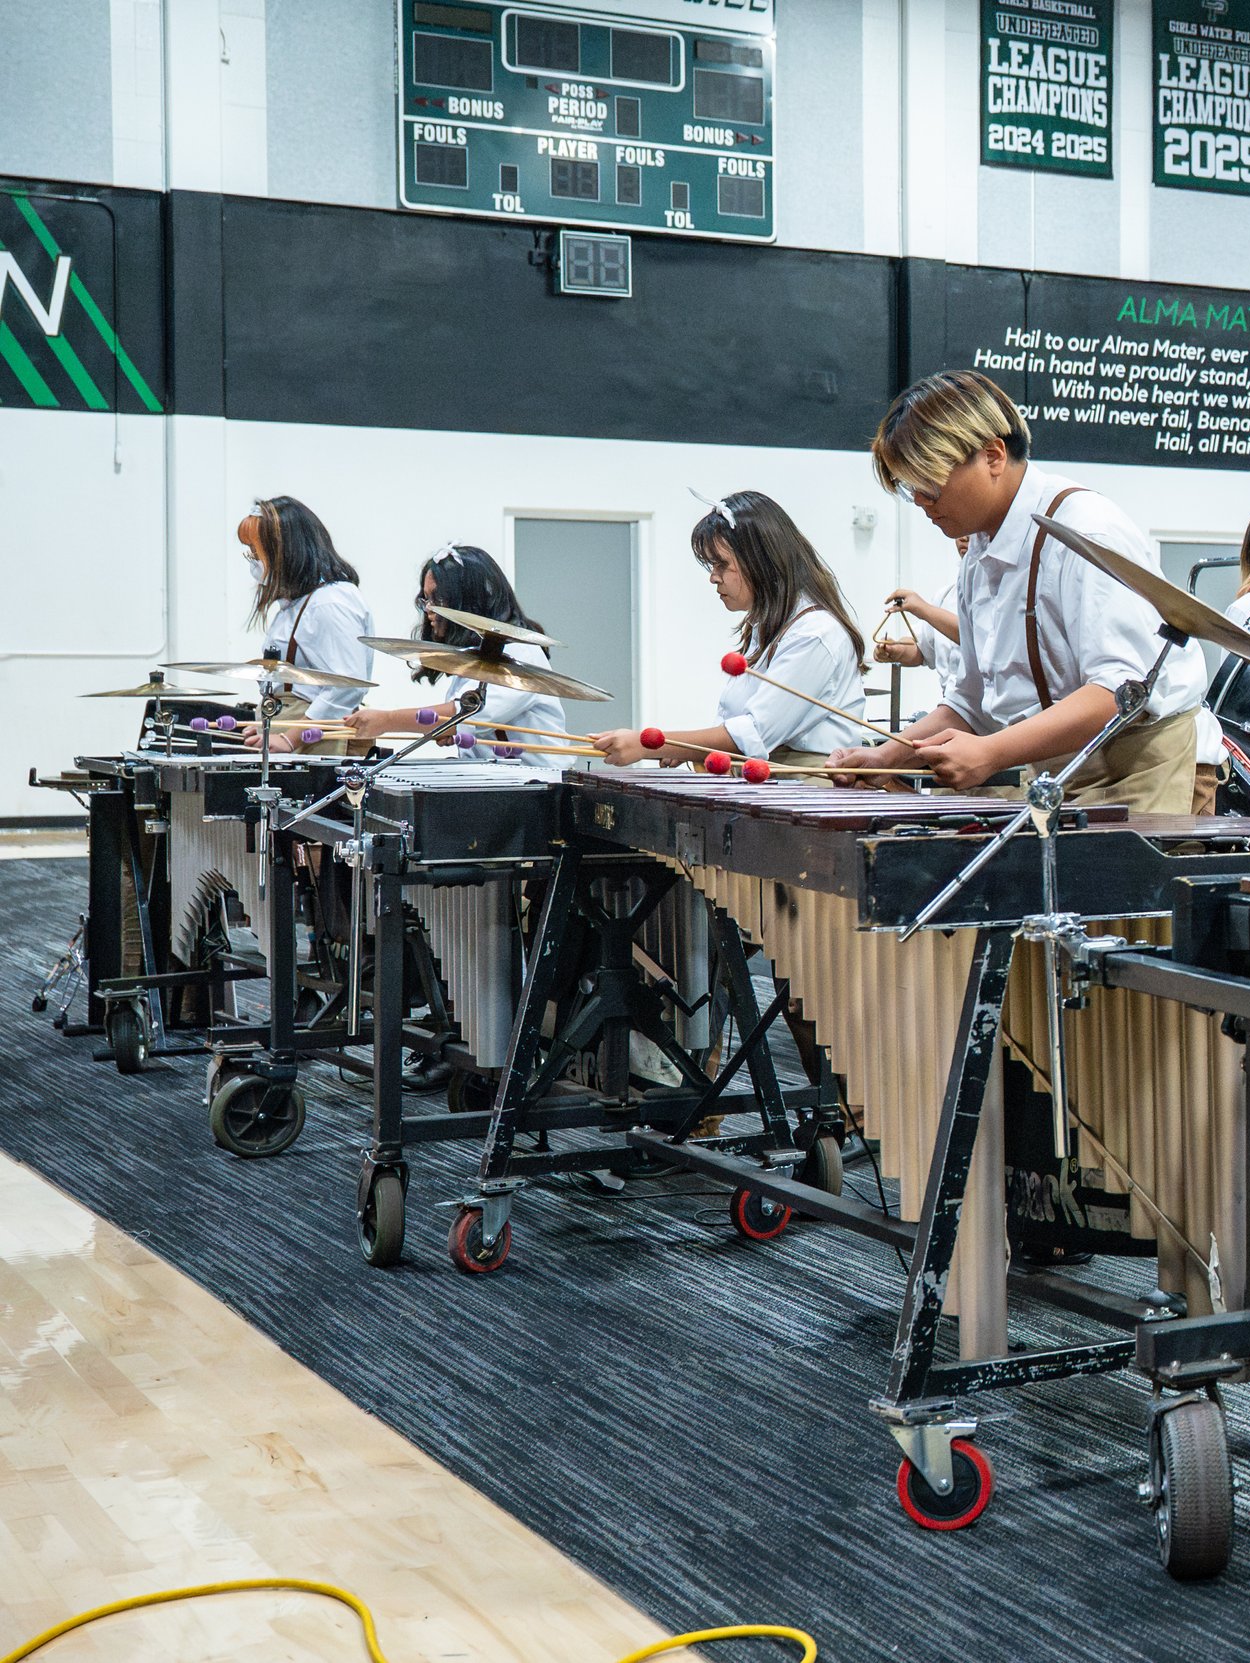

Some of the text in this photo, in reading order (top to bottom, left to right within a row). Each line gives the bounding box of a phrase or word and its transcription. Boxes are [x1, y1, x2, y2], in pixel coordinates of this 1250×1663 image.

[1032, 0, 1096, 18] BASKETBALL
[997, 13, 1099, 47] UNDEFEATED
[1169, 20, 1197, 35] GIRLS
[1200, 24, 1233, 40] WATER
[988, 37, 1107, 88] LEAGUE
[561, 82, 594, 99] POSS
[988, 75, 1107, 128] CHAMPIONS
[448, 96, 505, 120] BONUS
[548, 96, 608, 119] PERIOD
[413, 123, 468, 145] FOULS
[683, 124, 735, 147] BONUS
[988, 124, 1107, 164] 2024 2025
[537, 137, 599, 160] PLAYER
[615, 145, 665, 167] FOULS
[718, 157, 765, 178] FOULS
[492, 192, 525, 213] TOL
[664, 210, 695, 229] TOL
[1116, 295, 1198, 328] ALMA
[1004, 326, 1041, 349] Hail
[1044, 332, 1064, 350] to
[1067, 336, 1100, 352] our
[1100, 335, 1149, 357] Alma
[1152, 338, 1206, 364] Mater,
[1211, 348, 1249, 364] ever
[973, 348, 1027, 372] Hand
[1028, 355, 1045, 373] in
[1049, 353, 1096, 376] hand
[1099, 362, 1125, 378] we
[1128, 362, 1198, 387] proudly
[1199, 367, 1250, 390] stand,
[1052, 378, 1095, 400] With
[1098, 382, 1149, 403] noble
[1152, 384, 1200, 407] heart
[1203, 392, 1228, 408] we
[1015, 403, 1038, 421] ou
[1043, 406, 1070, 422] we
[1074, 404, 1106, 424] will
[1108, 411, 1158, 427] never
[1161, 408, 1193, 432] fail,
[1197, 411, 1250, 432] Buena
[1154, 431, 1194, 455] Hail,
[1198, 434, 1220, 453] all
